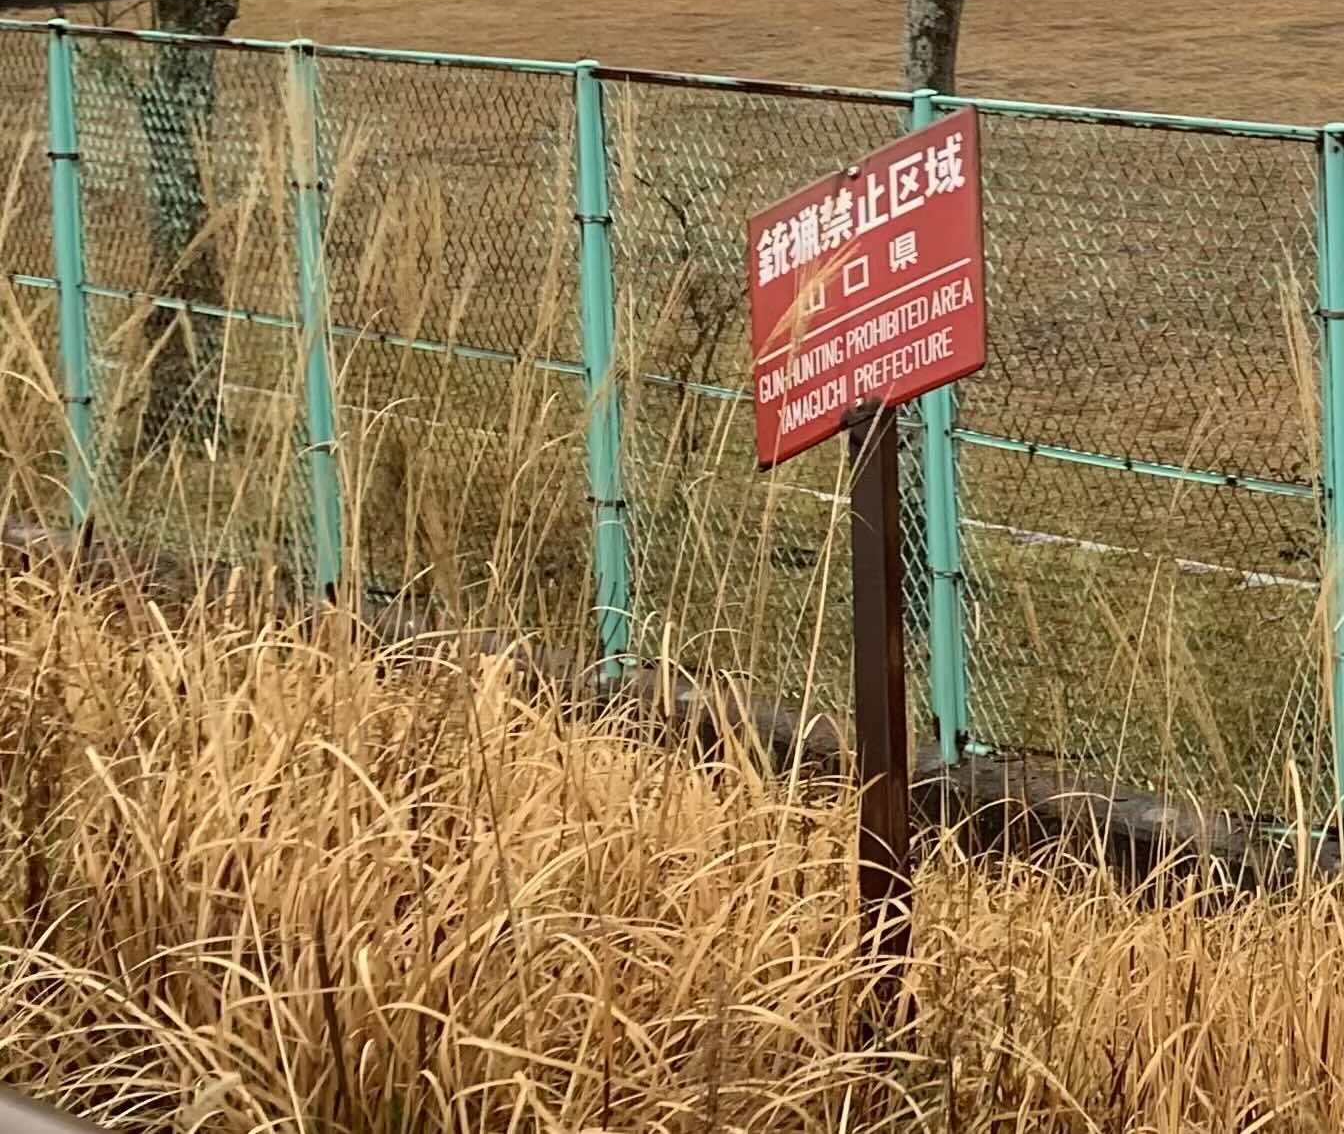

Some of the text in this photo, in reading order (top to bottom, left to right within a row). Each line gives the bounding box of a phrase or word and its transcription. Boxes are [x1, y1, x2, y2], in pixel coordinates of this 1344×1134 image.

[757, 132, 966, 286] 銃猟禁止区域
[845, 296, 929, 359] PROHIBITED
[930, 276, 974, 320] AREA
[776, 327, 954, 435] YAMAGUCHI PREFECTURE
